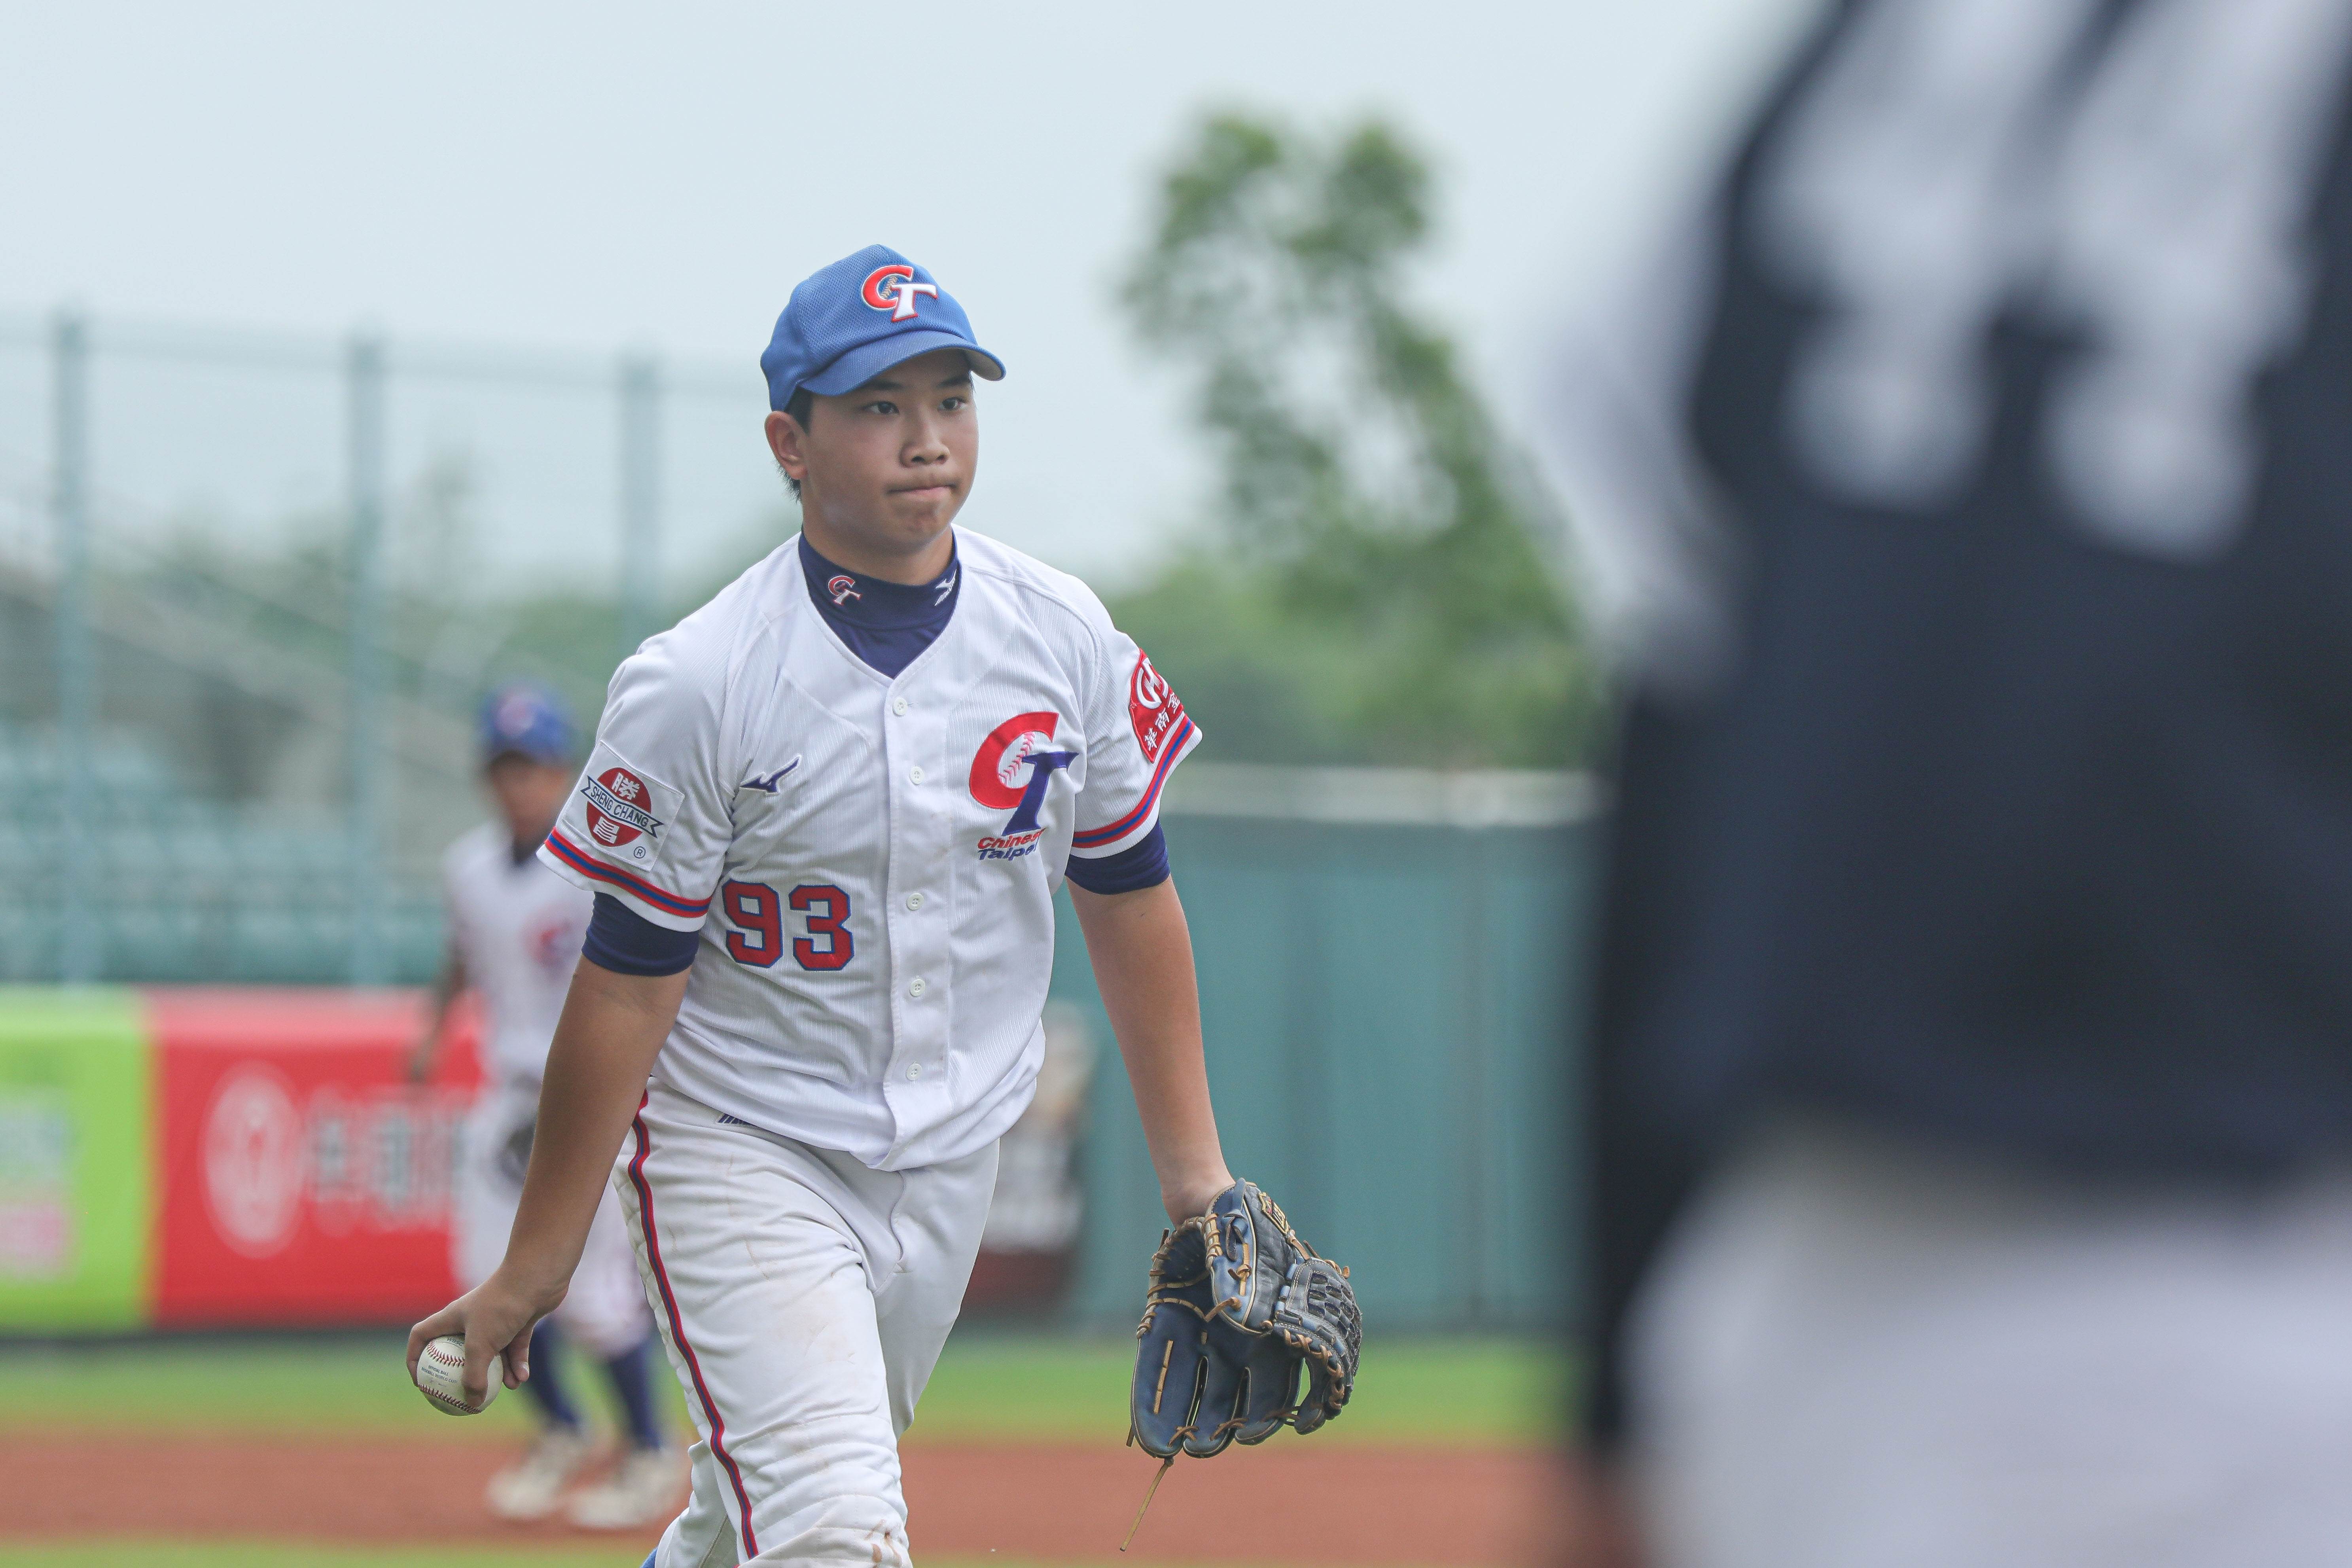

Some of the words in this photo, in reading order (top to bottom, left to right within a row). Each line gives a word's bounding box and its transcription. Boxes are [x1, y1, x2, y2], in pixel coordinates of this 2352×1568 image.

[591, 786, 613, 811] SHENG
[614, 805, 649, 827] CHANG
[611, 772, 640, 800] 勝
[722, 878, 854, 971] 93
